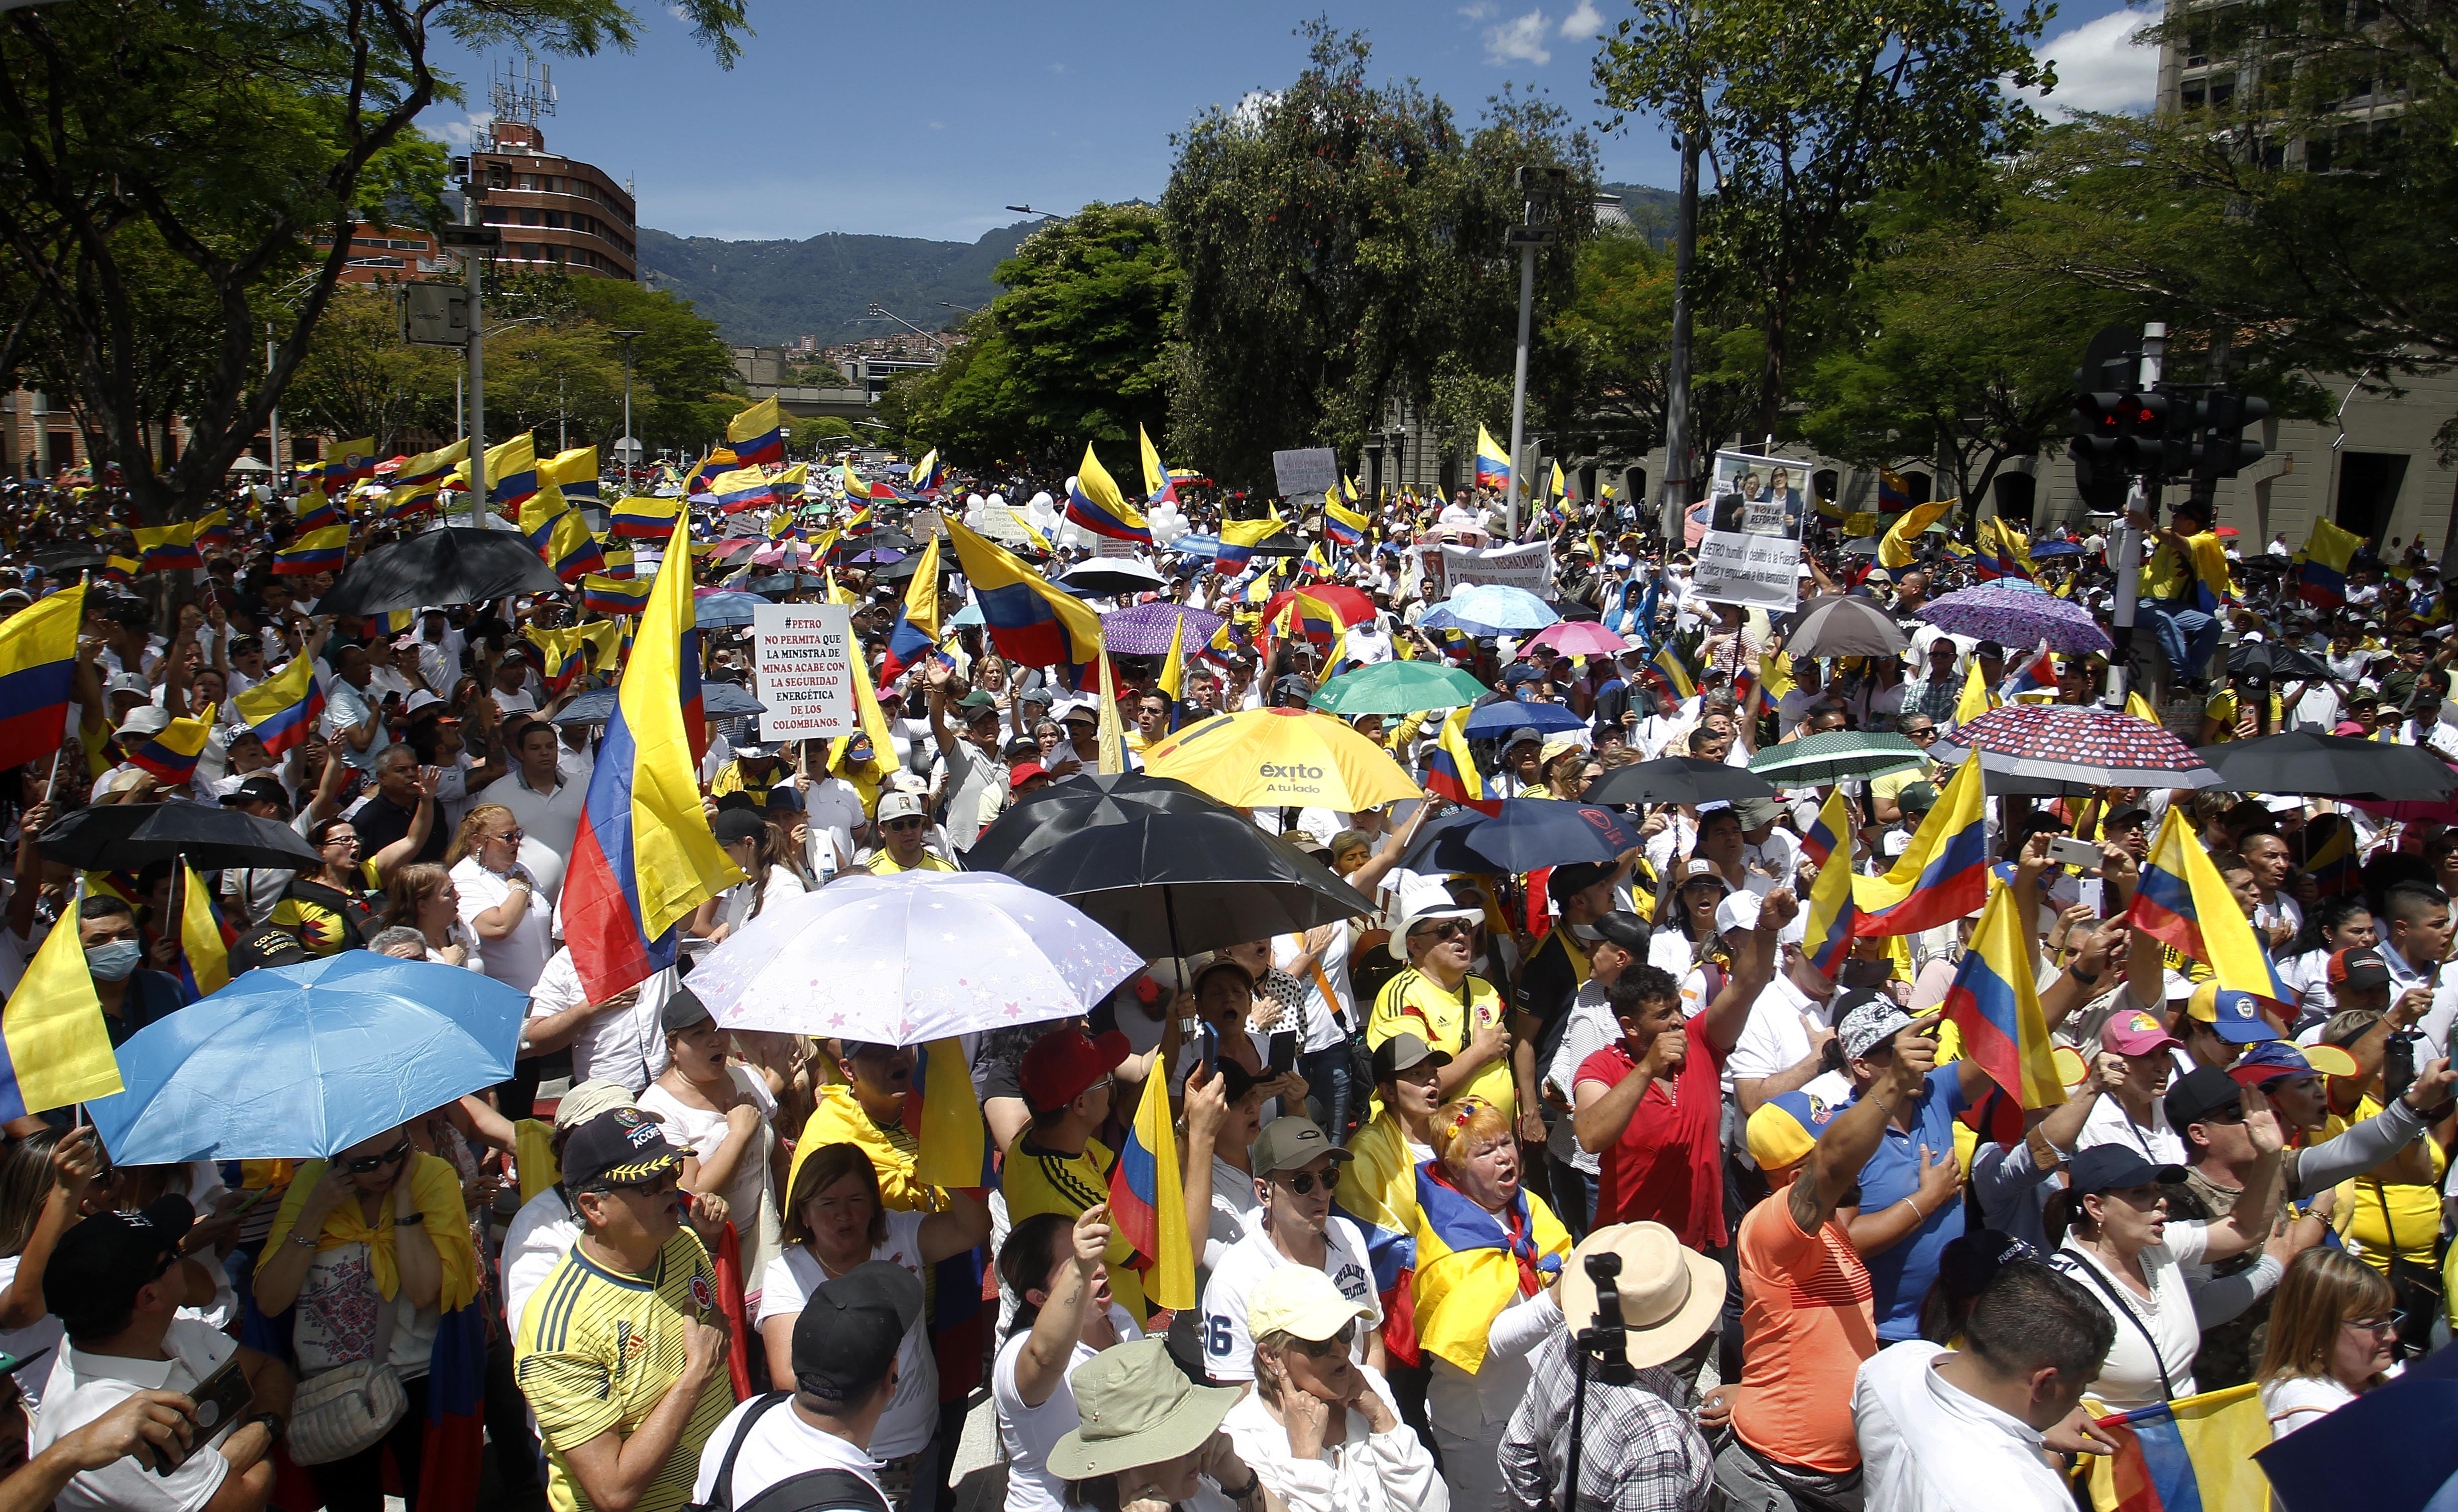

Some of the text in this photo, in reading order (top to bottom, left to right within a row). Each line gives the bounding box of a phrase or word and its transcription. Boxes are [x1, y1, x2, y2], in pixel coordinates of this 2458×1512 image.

[1755, 506, 1766, 514] NO
[1751, 515, 1783, 525] REFORMAS
[1705, 542, 1725, 556] PETRO
[1744, 550, 1749, 563] y
[1767, 553, 1772, 563] a
[1773, 551, 1778, 564] la
[1493, 554, 1545, 569] RECHAZAMOS
[1450, 573, 1458, 586] EL
[1700, 561, 1719, 576] Pública
[1719, 567, 1724, 579] y
[1751, 571, 1756, 581] a
[1757, 569, 1765, 582] los
[1790, 575, 1794, 588] y
[785, 617, 822, 629] #PETRO
[765, 635, 841, 646] NO PERMITA QUE
[767, 649, 840, 659] LA MINISTRA DE
[762, 662, 845, 673] MINAS ACABE CON
[771, 676, 838, 687] LA SEGURIDAD
[776, 689, 834, 701] ENERGÉTICA
[791, 705, 821, 715] DE LOS
[773, 718, 840, 730] COLOMBIANOS.
[1260, 762, 1323, 783] éxito
[1293, 784, 1320, 793] lado
[1204, 1311, 1233, 1356] 6
[627, 1342, 650, 1359] adidas
